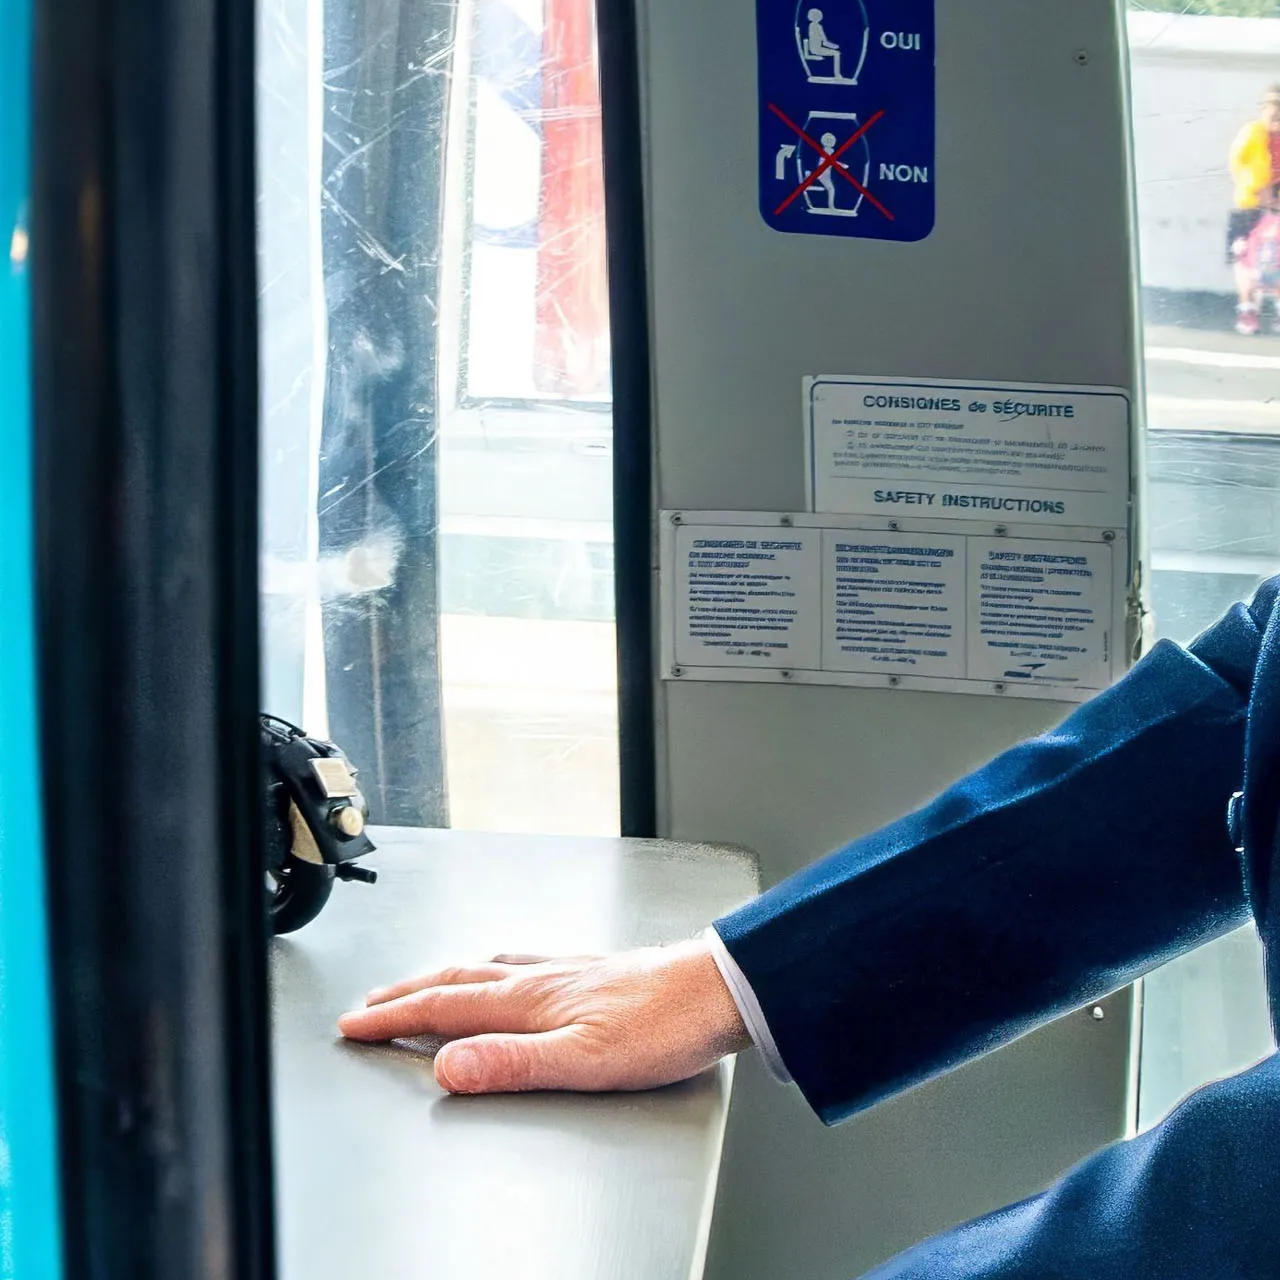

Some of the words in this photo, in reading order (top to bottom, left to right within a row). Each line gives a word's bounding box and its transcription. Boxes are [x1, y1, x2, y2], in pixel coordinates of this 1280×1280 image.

[880, 31, 920, 50] OUI
[879, 163, 928, 183] NON
[863, 394, 961, 412] CONSIGNES
[968, 401, 986, 413] de
[874, 489, 936, 506] SAFETY
[942, 493, 1065, 514] INSTRUCTIONS
